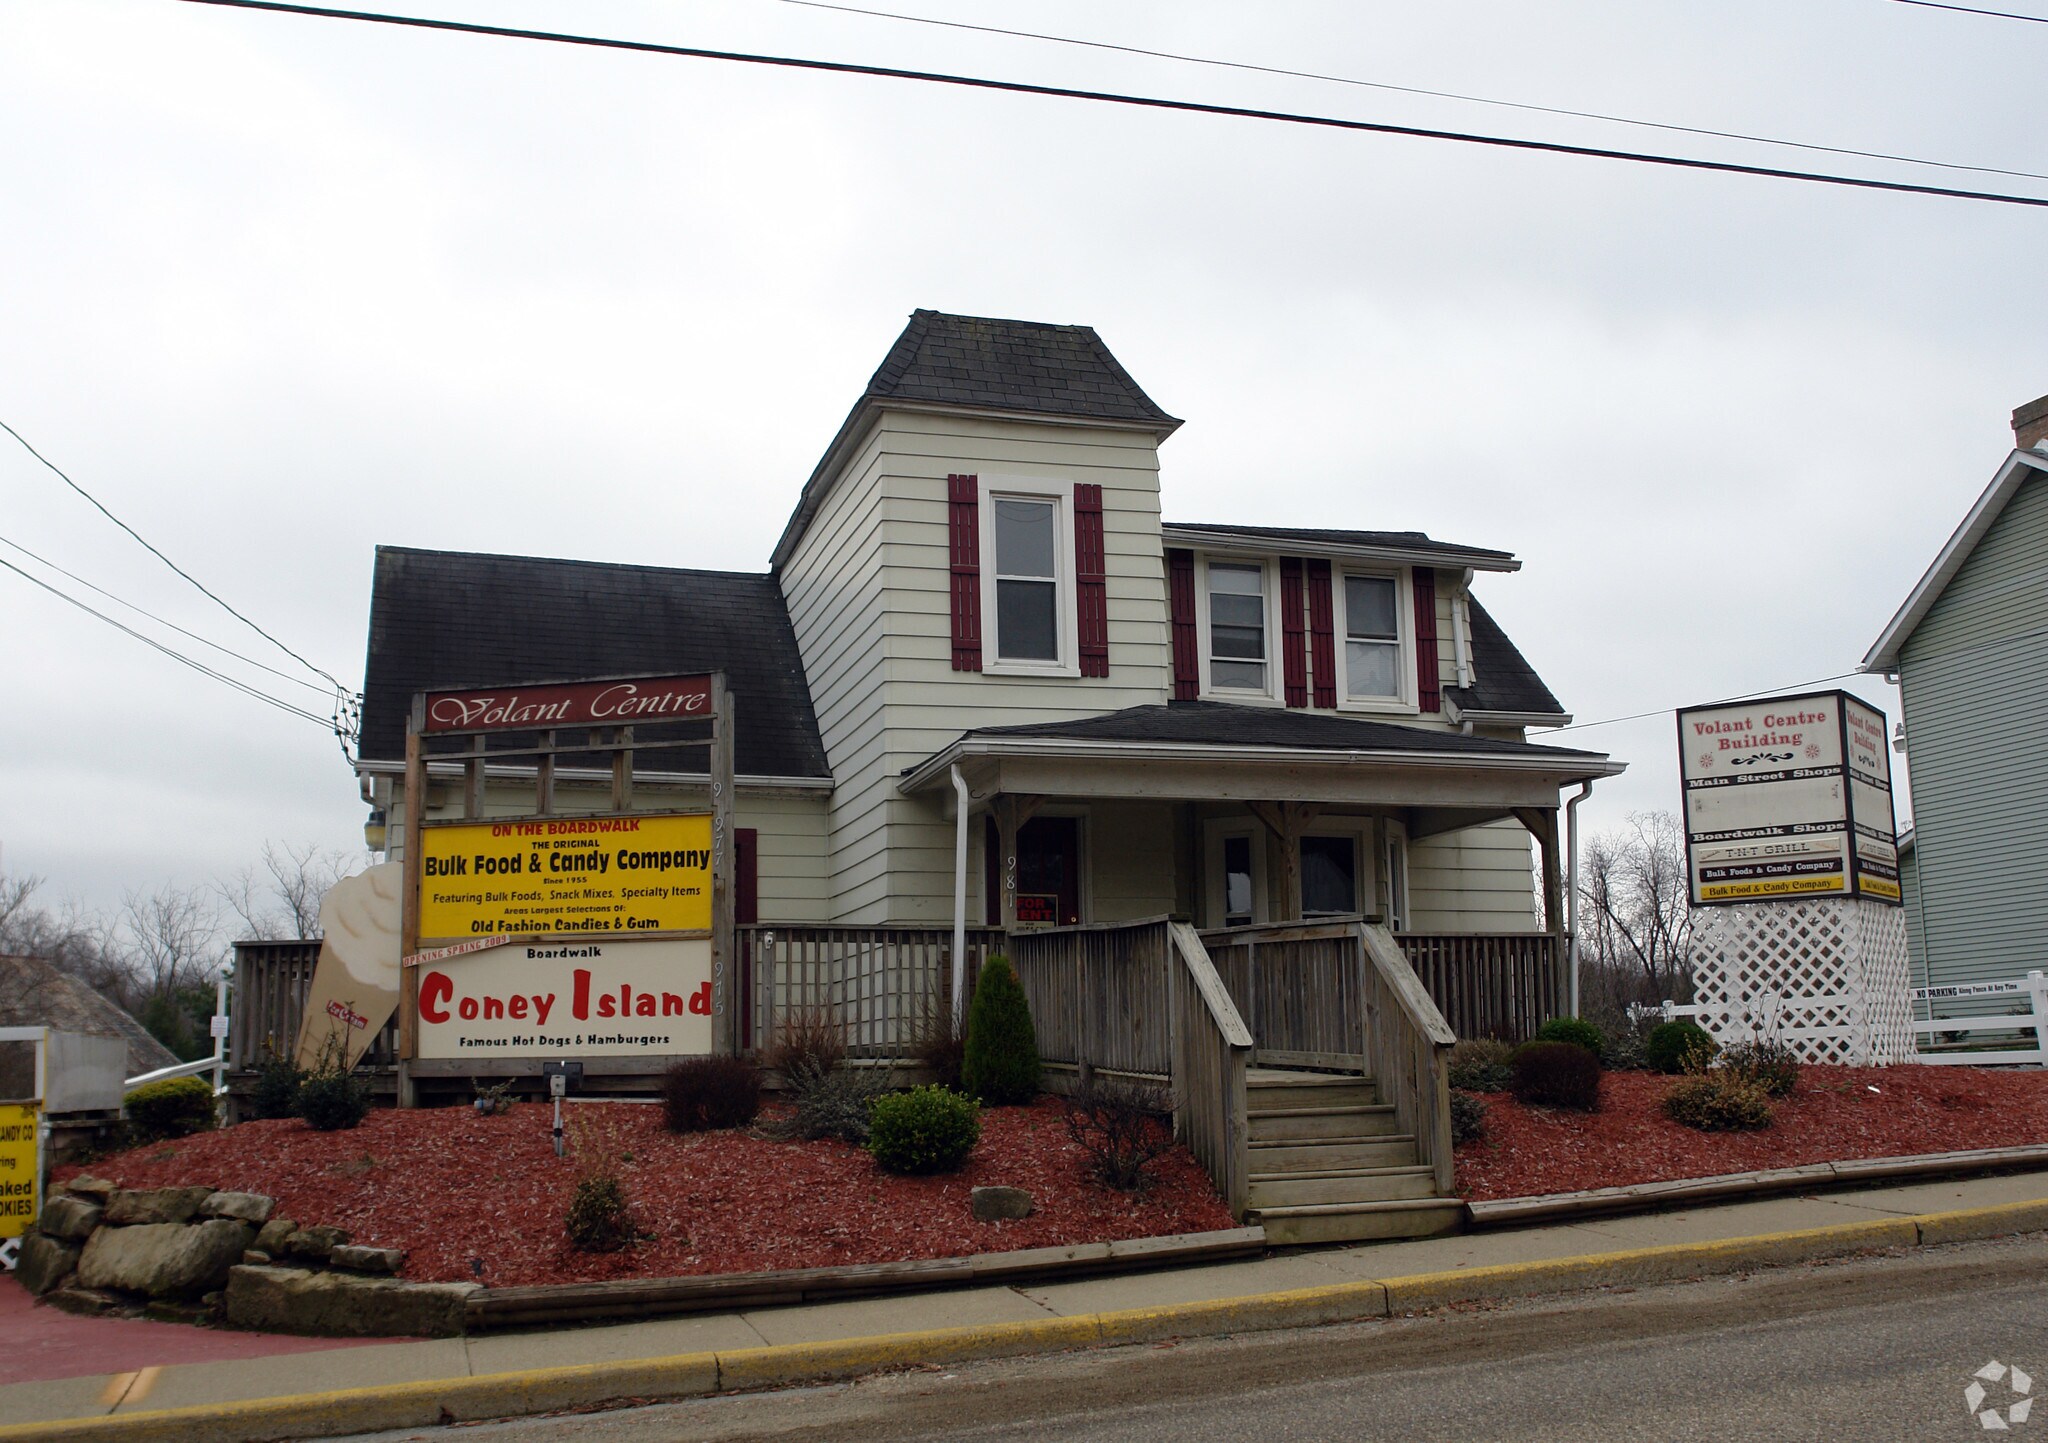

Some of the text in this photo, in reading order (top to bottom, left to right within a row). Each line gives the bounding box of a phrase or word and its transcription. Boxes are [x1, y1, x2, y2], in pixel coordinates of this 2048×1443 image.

[431, 684, 707, 726] Volant Centre
[1694, 711, 1827, 736] Volant Centre
[1718, 732, 1803, 751] Building
[1689, 766, 1841, 788] Main Street Shops
[492, 819, 641, 837] ON THE BOARDWALK
[1692, 827, 1784, 842] Boardwalk
[1793, 821, 1845, 833] Shops
[532, 839, 600, 850] THE ORIGINAL
[1764, 843, 1811, 855] GRILL
[425, 849, 711, 876] Bulk Food & Candy Company
[1706, 861, 1835, 878] Bulk Foods & Candy Company
[543, 876, 588, 885] Since 1955
[1709, 879, 1832, 896] Bulk Food & Candy Company
[433, 891, 482, 904] Featuring
[485, 891, 508, 902] Bulk
[511, 890, 544, 902] Foods,
[550, 889, 580, 900] Snack
[621, 886, 668, 899] Specialty
[671, 886, 701, 897] Items
[1017, 898, 1045, 909] FOR
[531, 907, 563, 915] Largest
[566, 905, 611, 914] Selections
[471, 916, 659, 933] Old Fashion Candies & Gum
[404, 934, 507, 966] OPENING SPRING 2009
[527, 948, 602, 959] Boardwalk
[418, 968, 712, 1026] Coney Island
[1916, 989, 1926, 999] NO
[1928, 987, 1958, 998] PARKING
[459, 1034, 670, 1047] Famous Hot Dogs & Hamburgers
[0, 1125, 33, 1142] ANDY CO
